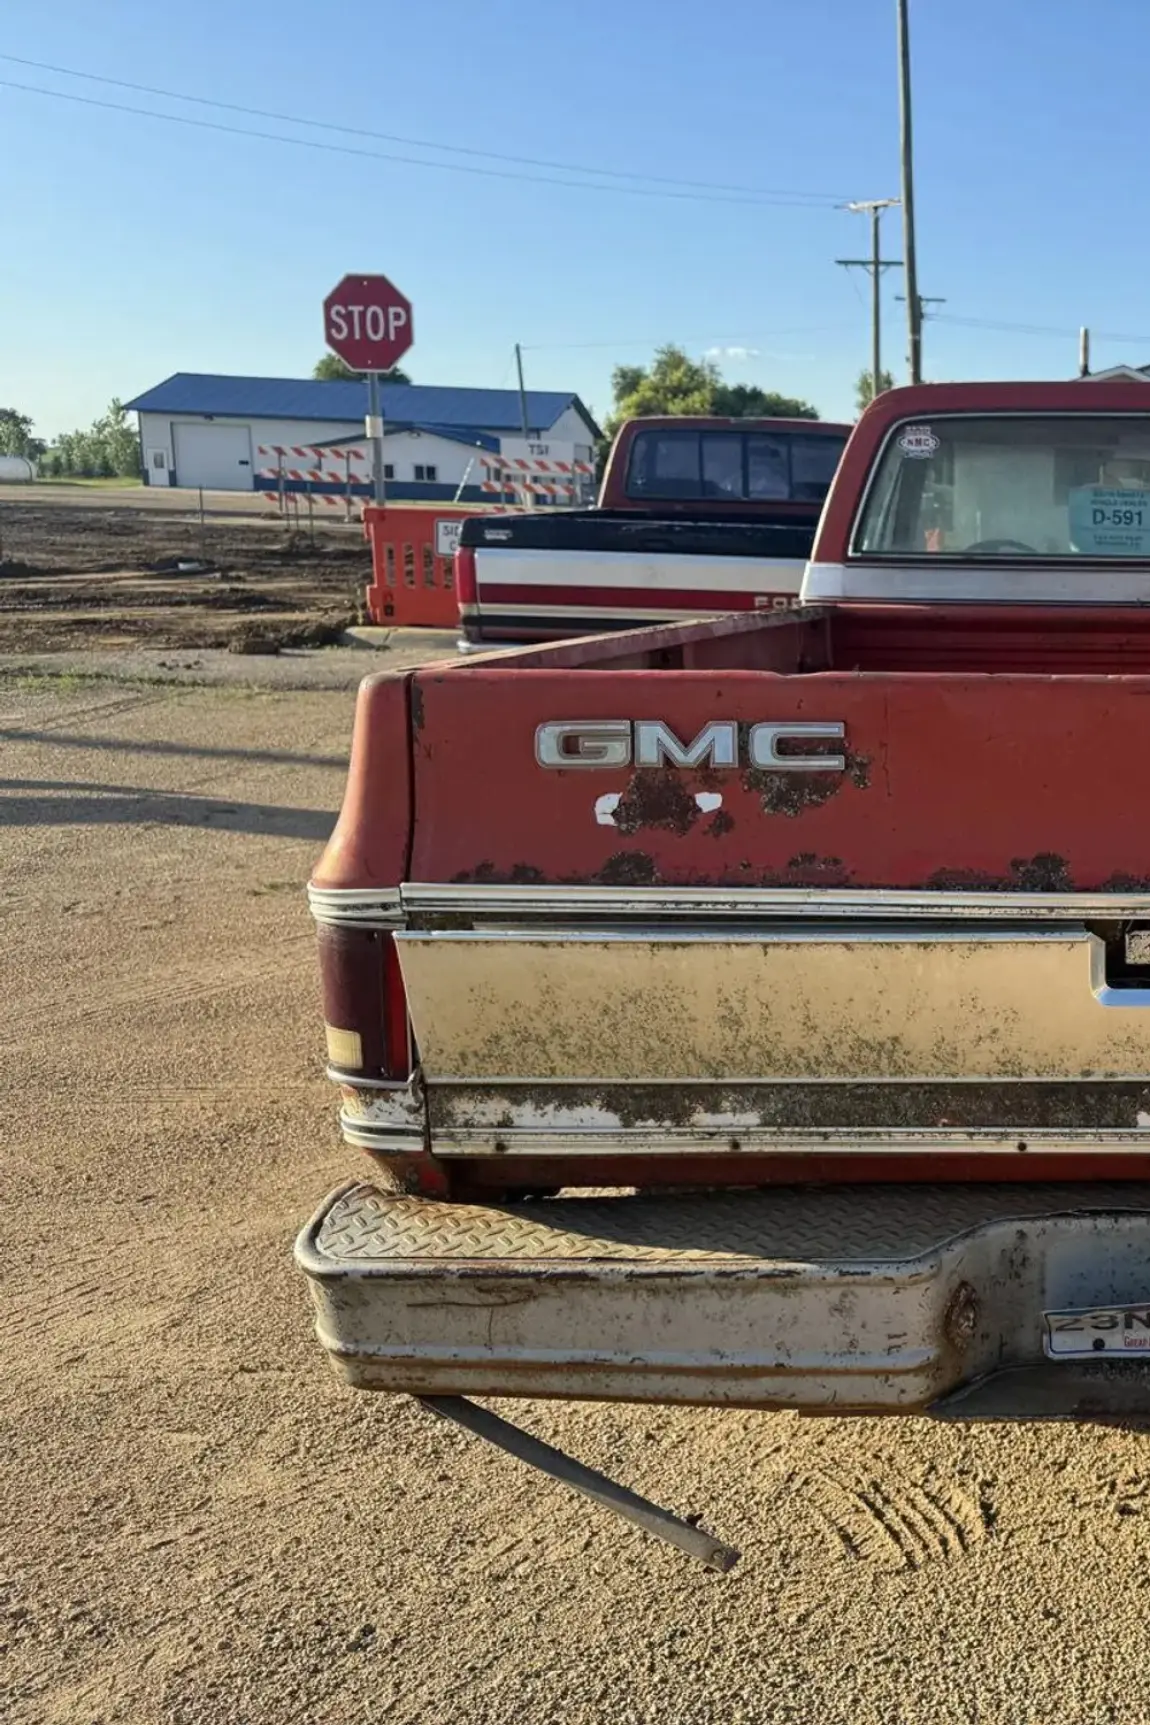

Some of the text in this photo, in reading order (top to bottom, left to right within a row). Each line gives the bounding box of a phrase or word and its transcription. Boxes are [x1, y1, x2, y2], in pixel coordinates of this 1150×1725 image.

[330, 304, 407, 341] STOP
[528, 444, 549, 456] TSI
[1092, 509, 1143, 526] D-591
[535, 720, 845, 770] GMC
